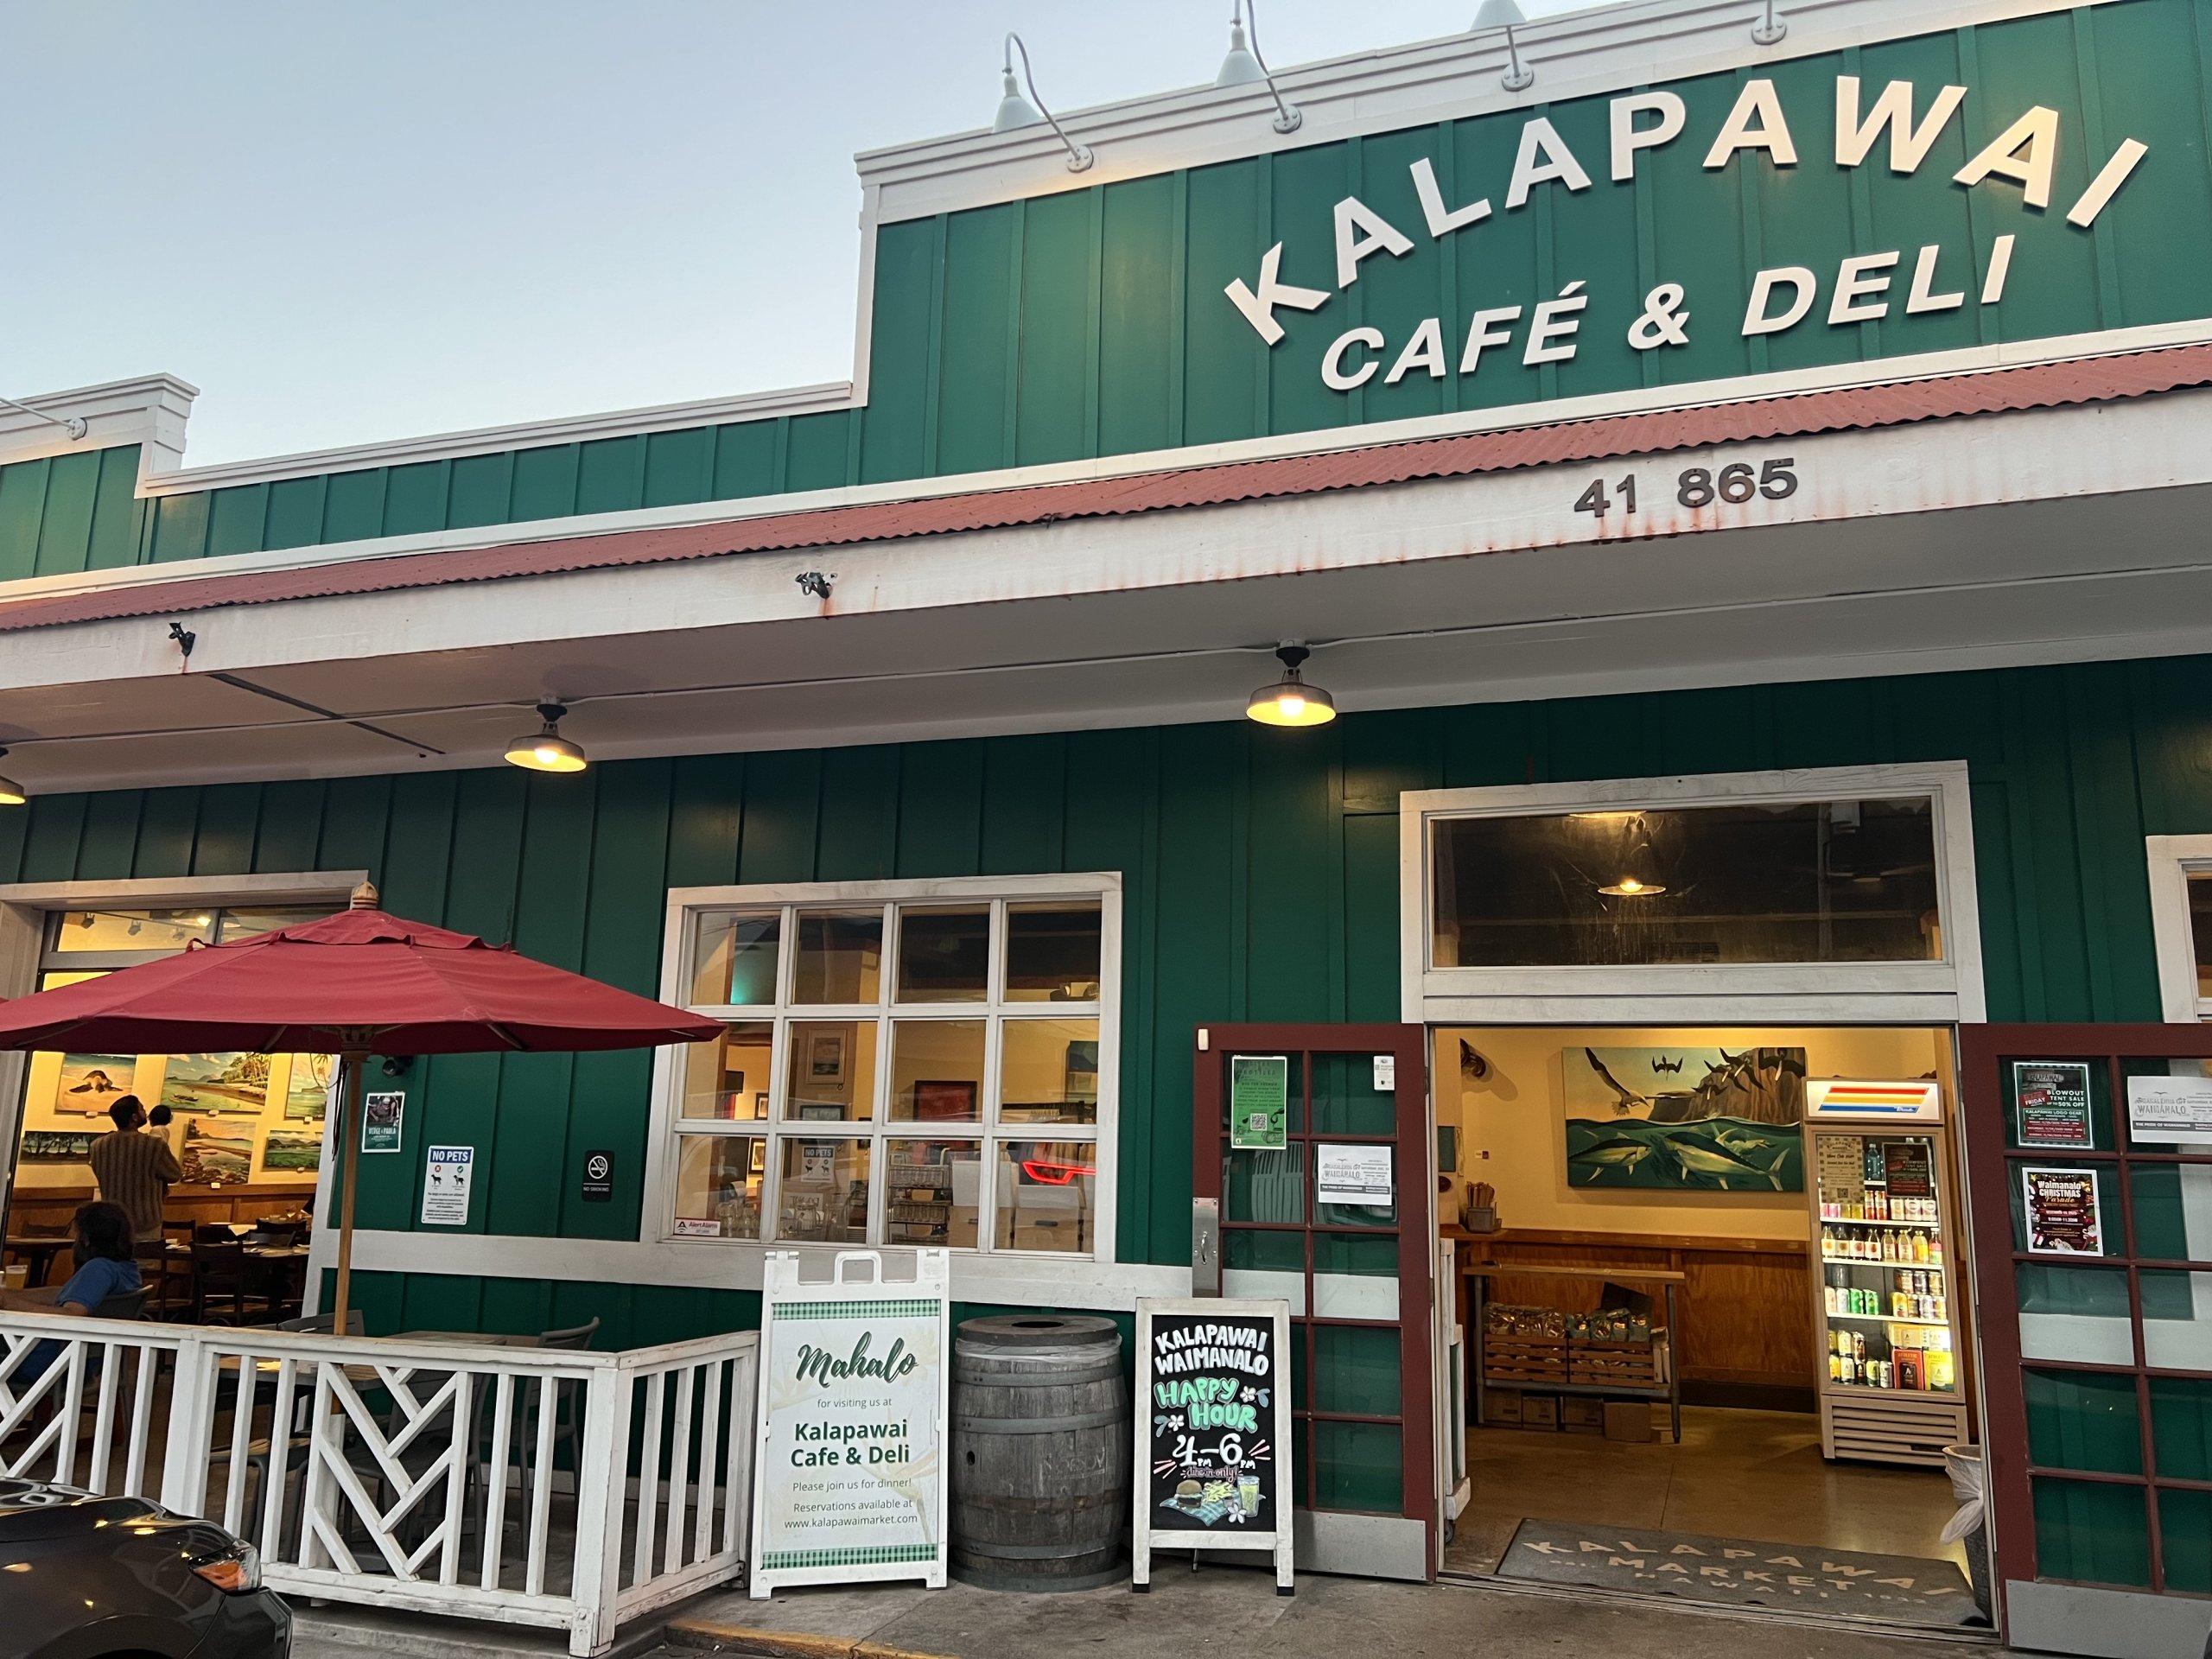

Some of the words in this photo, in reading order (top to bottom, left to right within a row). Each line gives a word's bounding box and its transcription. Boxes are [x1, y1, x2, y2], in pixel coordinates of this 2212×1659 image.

[1224, 75, 2148, 346] KALAPAWAI
[1321, 281, 1588, 391] CAFÉ
[1628, 283, 1690, 349] &
[1742, 234, 2015, 335] DELI
[1574, 479, 1637, 518] 41
[1677, 458, 1798, 507] 865
[2025, 1097, 2046, 1106] FRIDAY
[432, 1150, 445, 1161] NO
[446, 1151, 468, 1162] PETS
[2037, 1180, 2082, 1190] Waimanalo
[2039, 1189, 2081, 1198] CHRISTMAS
[1154, 1324, 1268, 1355] KALAPAWAI
[796, 1331, 919, 1388] Mahalo
[1154, 1347, 1268, 1376] WAIMANALO
[817, 1399, 831, 1408] for
[833, 1399, 866, 1408] visiting
[883, 1398, 892, 1407] at
[1154, 1377, 1239, 1409] HAPPY
[1187, 1402, 1258, 1433] HOUR
[795, 1419, 907, 1445] Kalapawai
[791, 1446, 839, 1467] Cafe
[845, 1446, 862, 1465] &
[869, 1445, 910, 1464] Deli
[1198, 1458, 1211, 1467] PM
[1241, 1459, 1256, 1469] PM
[793, 1483, 824, 1491] Please
[826, 1481, 844, 1493] join
[847, 1481, 859, 1490] us
[861, 1479, 874, 1489] for
[878, 1478, 912, 1488] dinner!
[793, 1502, 855, 1512] Reservations
[859, 1499, 900, 1510] available
[785, 1515, 918, 1529] www.kalapawaimarket.com
[1523, 1541, 1958, 1595] KALAPAWAI
[1609, 1556, 1856, 1590] MARKET
